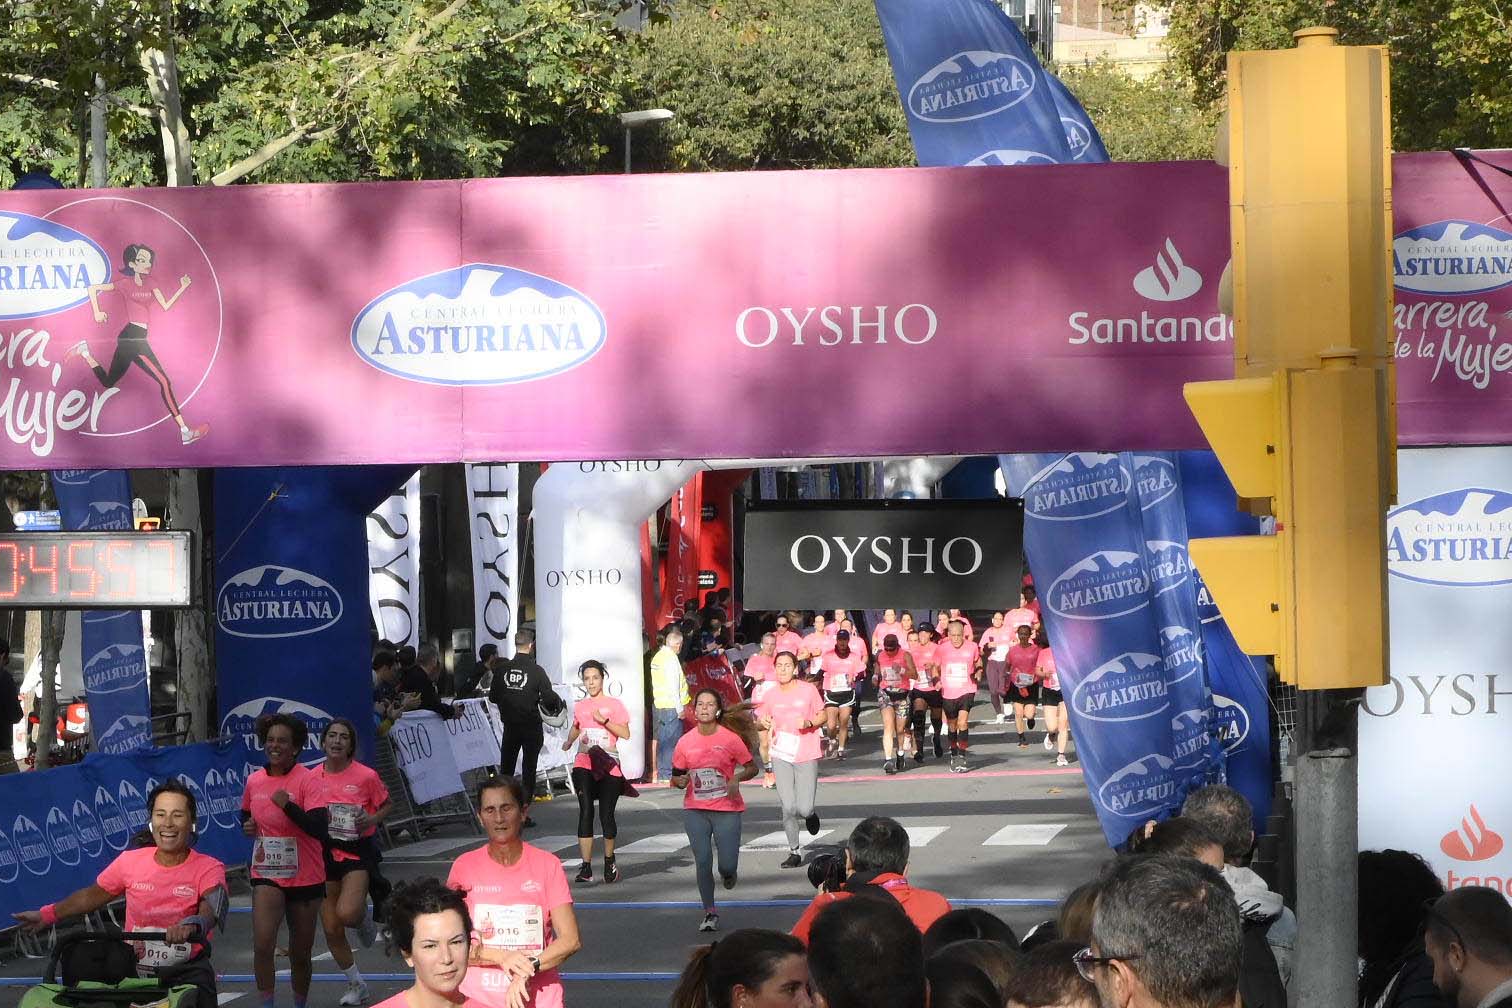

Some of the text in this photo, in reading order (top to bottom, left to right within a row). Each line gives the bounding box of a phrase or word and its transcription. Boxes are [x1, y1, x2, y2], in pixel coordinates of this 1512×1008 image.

[13, 247, 86, 258] LECHERA
[735, 303, 938, 348] OYSHO
[1393, 301, 1489, 330] arrera
[371, 310, 586, 356] ASTURIANA
[1417, 331, 1434, 358] la
[1431, 324, 1512, 390] Muje
[790, 535, 983, 576] OYSHO
[546, 568, 622, 589] OYSHO
[221, 593, 334, 622] ASTURIANA
[1360, 673, 1512, 718] OYSH
[147, 949, 169, 960] 016
[480, 972, 510, 986] SU
